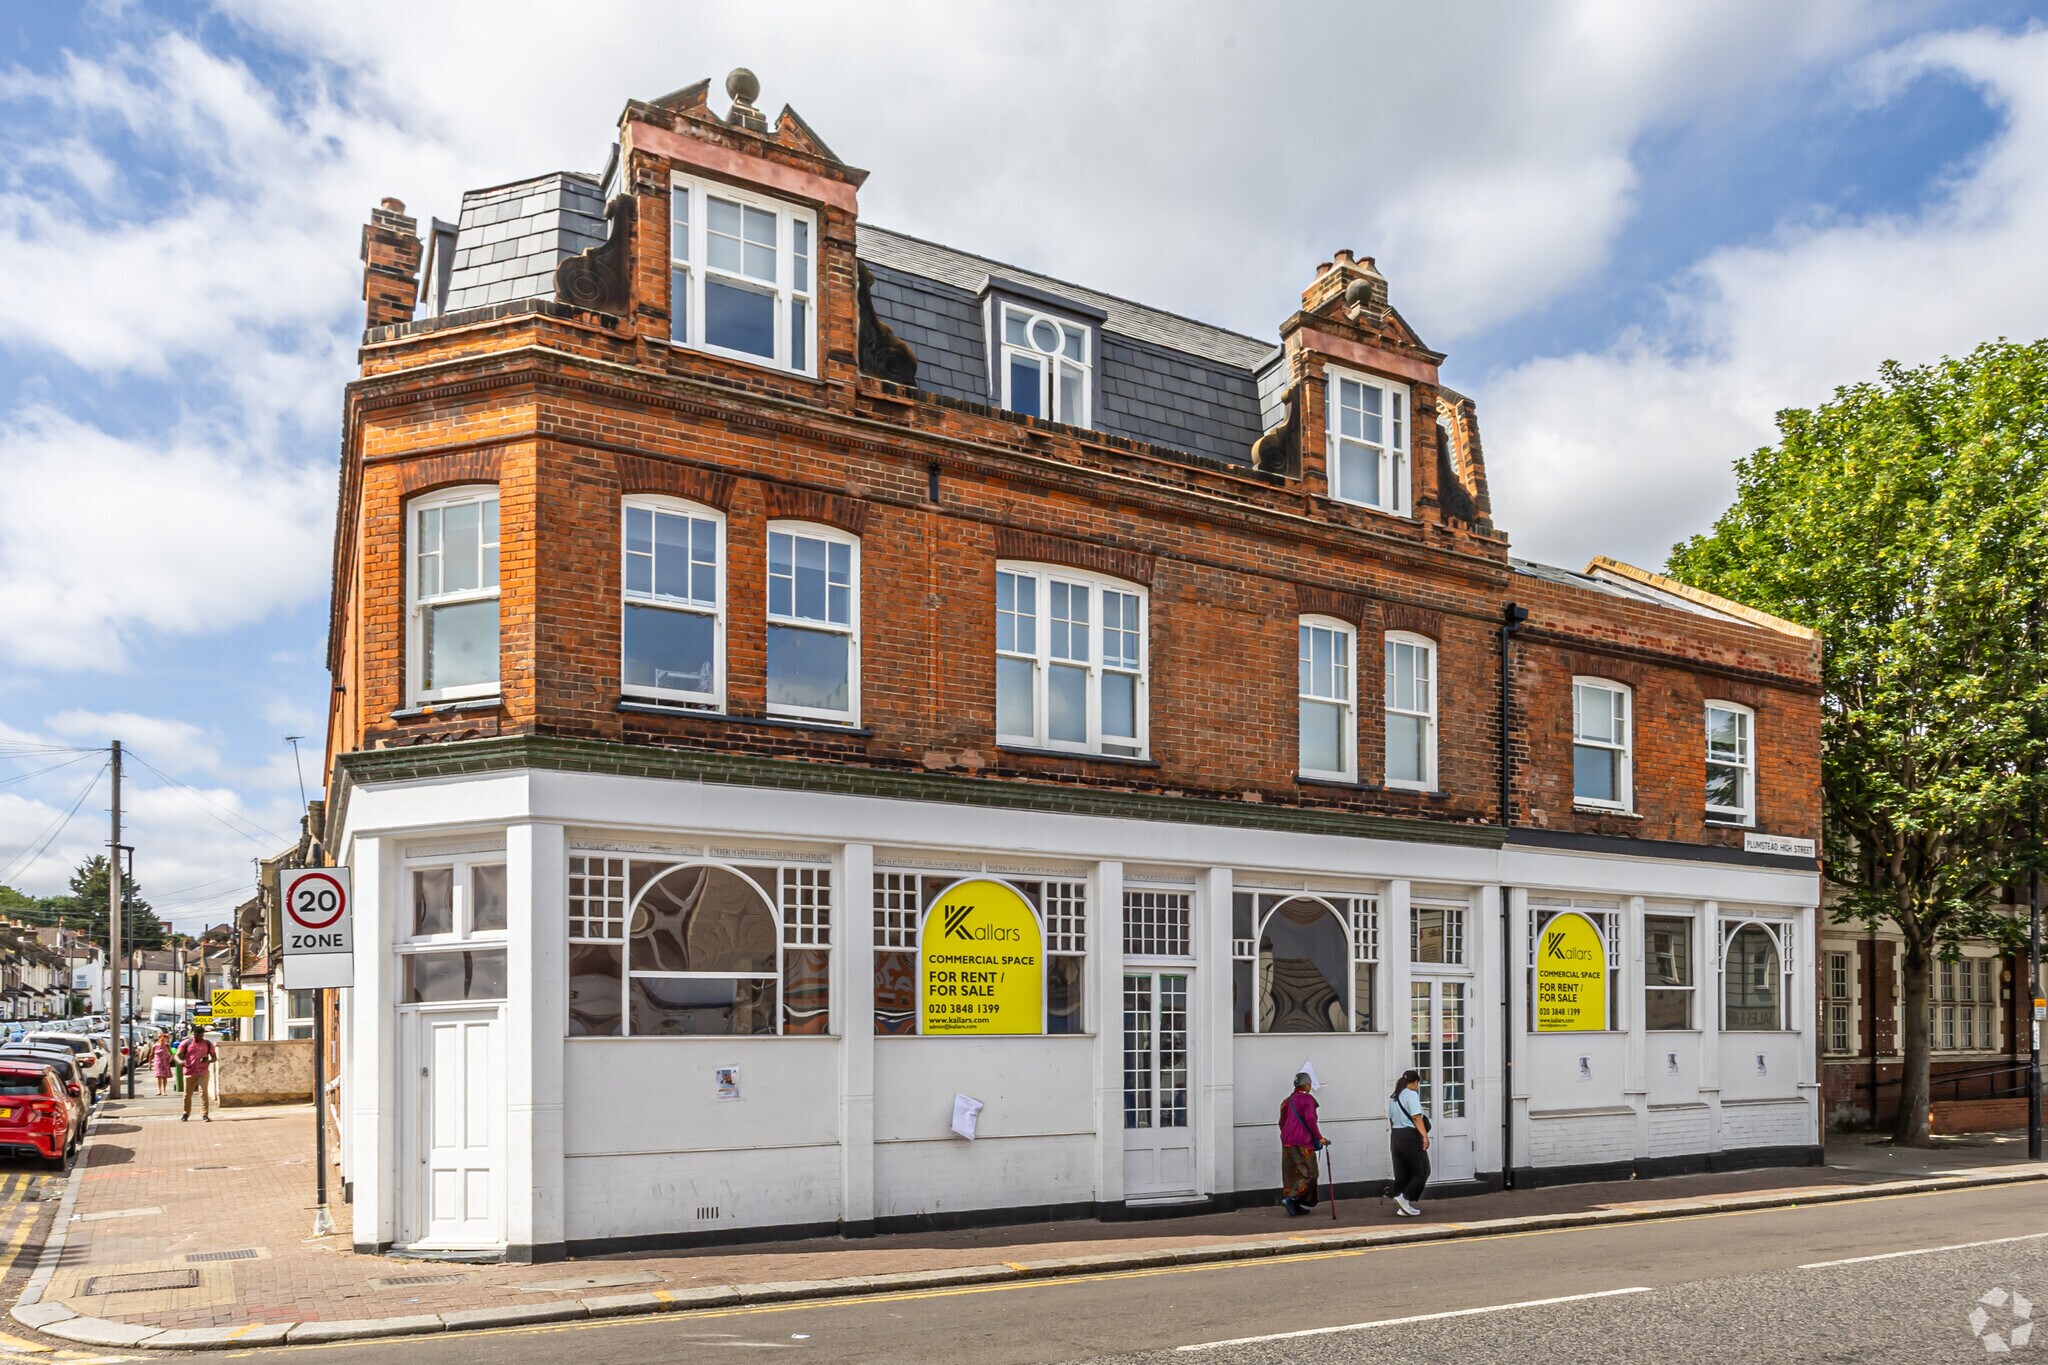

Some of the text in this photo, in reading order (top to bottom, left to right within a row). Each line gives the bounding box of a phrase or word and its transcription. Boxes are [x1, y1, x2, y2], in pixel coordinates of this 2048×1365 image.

[1746, 840, 1778, 851] PLUMSTEAD
[1780, 844, 1792, 852] HIGH
[1794, 845, 1813, 854] STREET
[298, 890, 337, 912] 20
[945, 905, 1021, 941] Kallars
[292, 934, 343, 948] ZONE
[1548, 932, 1592, 960] Kallars
[929, 955, 1034, 965] COMMERCIAL SPACE
[929, 971, 1005, 983] FOR RENT /
[1540, 970, 1600, 979] COMMERCIAL SPACE
[929, 985, 994, 996] FOR SALE
[1540, 983, 1556, 992] FOR
[1558, 983, 1579, 992] RENT
[1540, 993, 1577, 1002] FOR SALE
[929, 1004, 1000, 1013] 020 3848 1399
